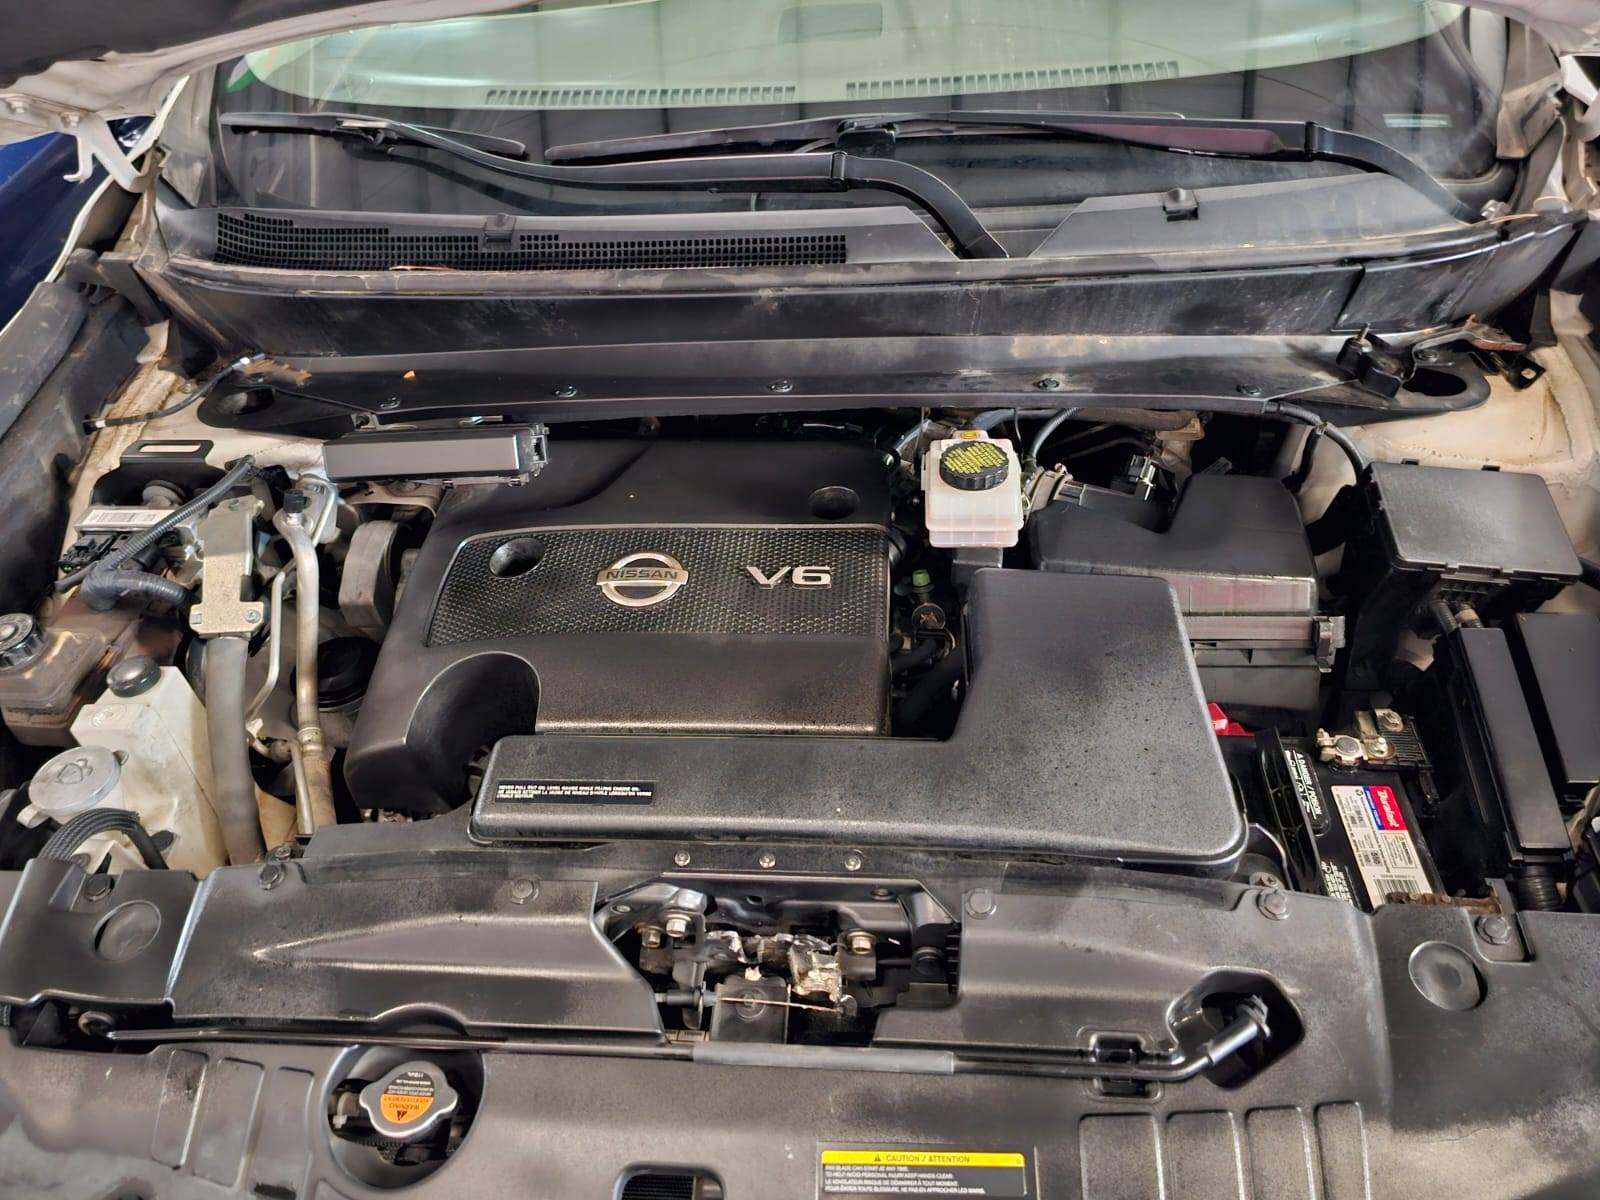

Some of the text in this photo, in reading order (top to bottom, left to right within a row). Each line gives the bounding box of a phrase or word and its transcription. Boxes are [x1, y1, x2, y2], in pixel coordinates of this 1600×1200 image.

[606, 570, 678, 580] NISSAN
[746, 566, 832, 589] V6
[1377, 790, 1399, 827] Duralast
[928, 1155, 970, 1163] ATTENTION
